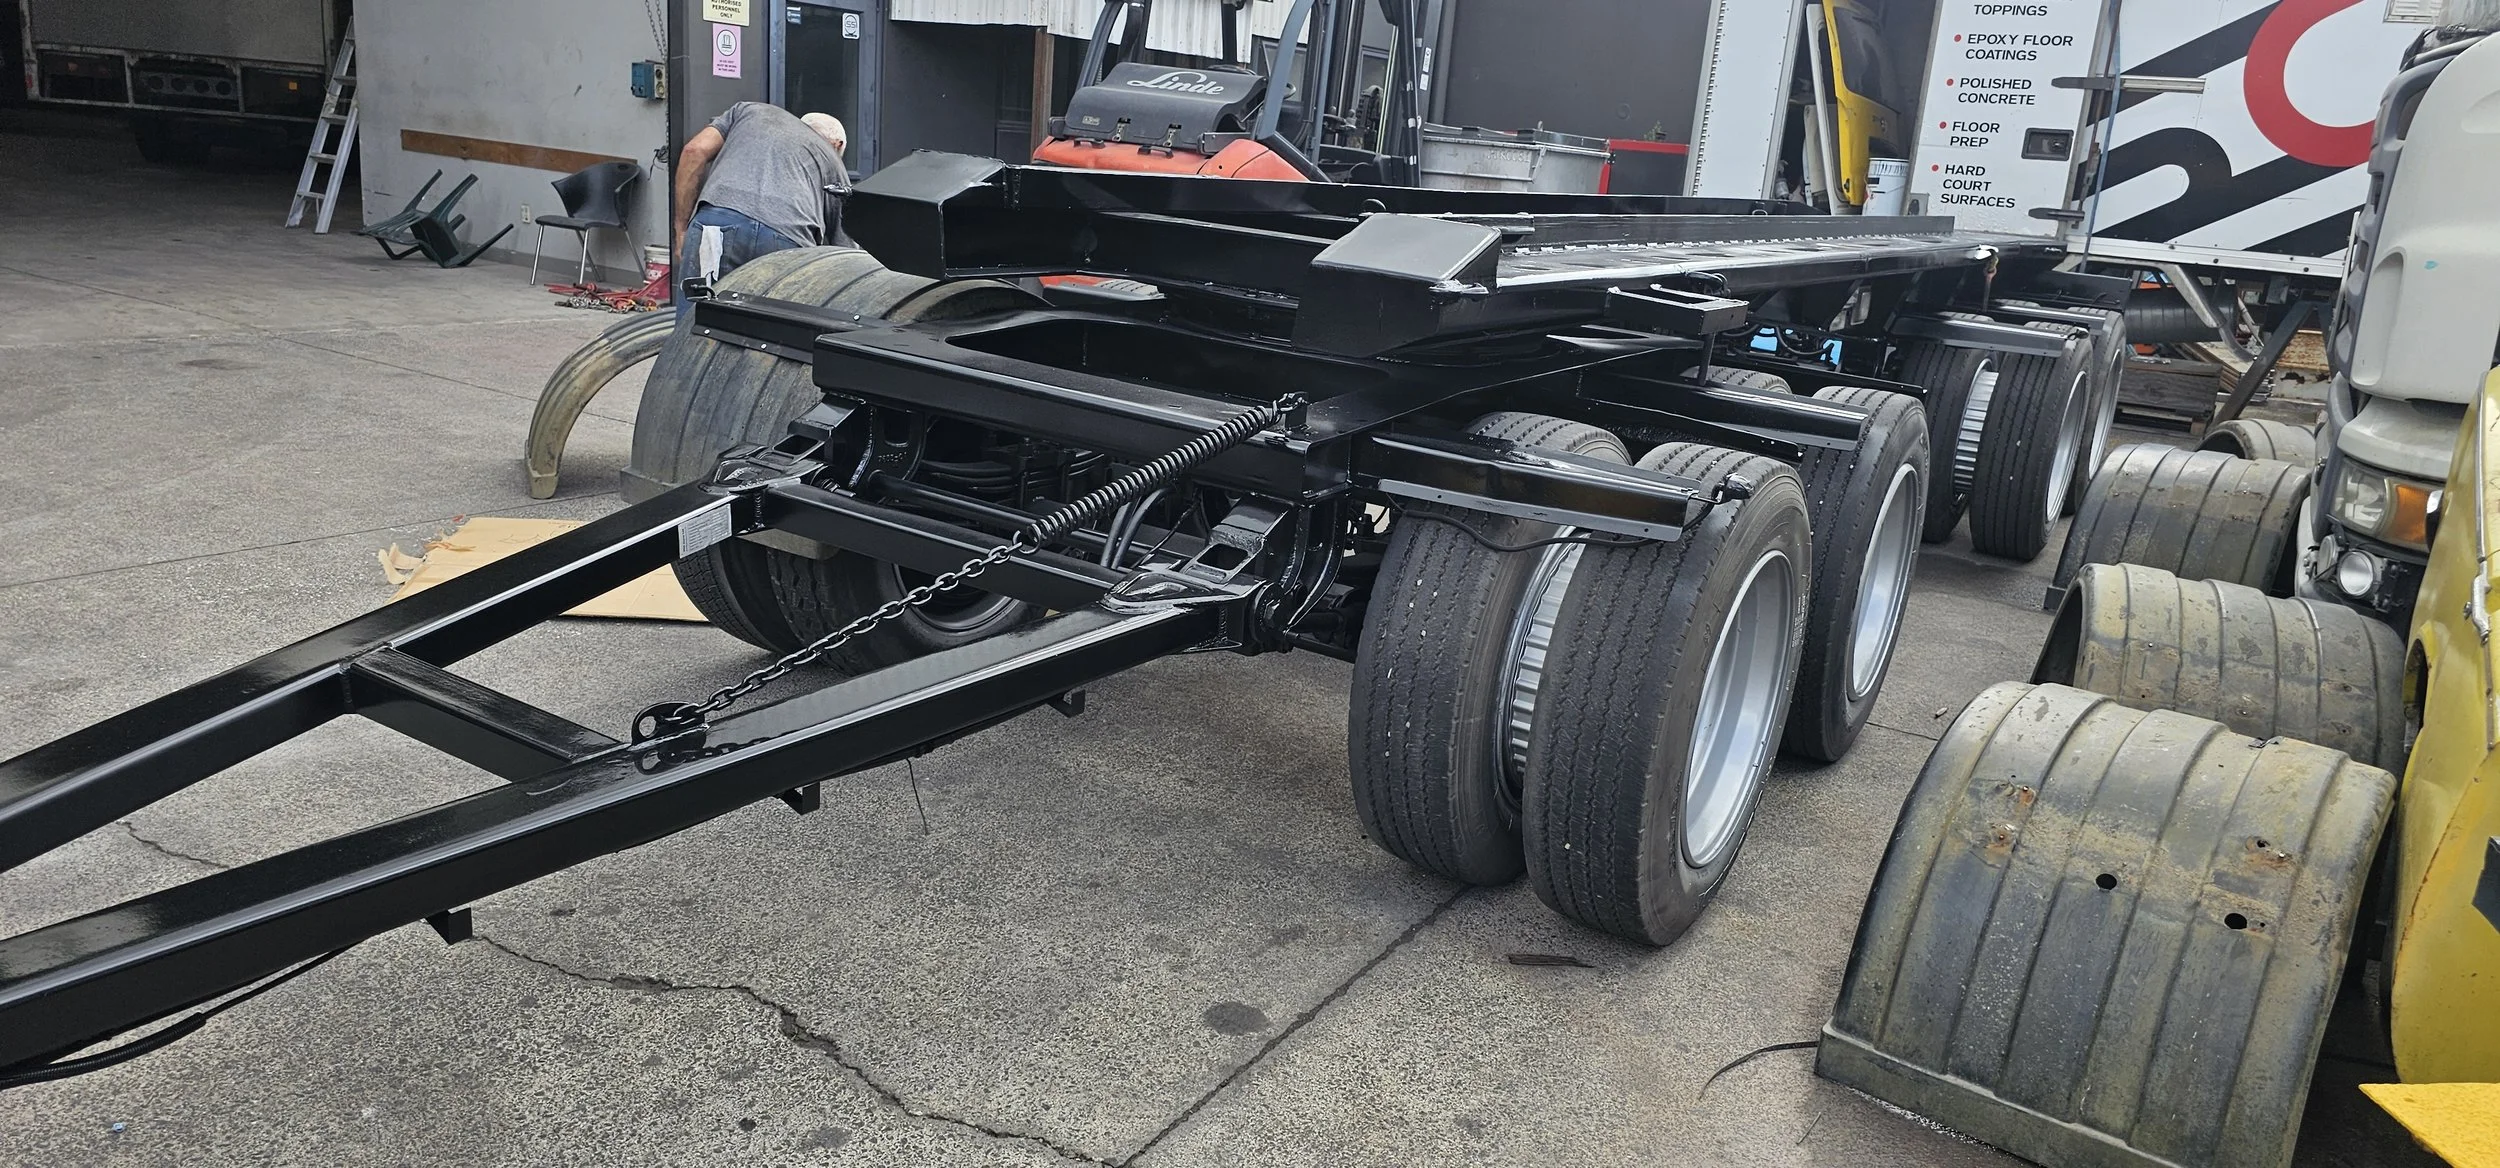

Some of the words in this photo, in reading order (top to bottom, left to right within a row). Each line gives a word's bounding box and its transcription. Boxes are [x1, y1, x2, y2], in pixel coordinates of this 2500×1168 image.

[712, 4, 741, 13] PERSONNEL
[1974, 4, 2048, 16] TOPPINGS
[1967, 34, 2018, 45] EPOXY
[2023, 35, 2073, 46] FLOOR
[1965, 49, 2037, 61] COATINGS
[1127, 71, 1225, 95] Linde
[1960, 78, 2032, 90] POLISHED
[1958, 92, 2036, 105] CONCRETE
[1952, 121, 2000, 133] FLOOR
[1950, 136, 1988, 147] PREP
[1945, 164, 1985, 176] HARD
[1943, 179, 1991, 191] COURT
[1940, 193, 2015, 208] SURFACES
